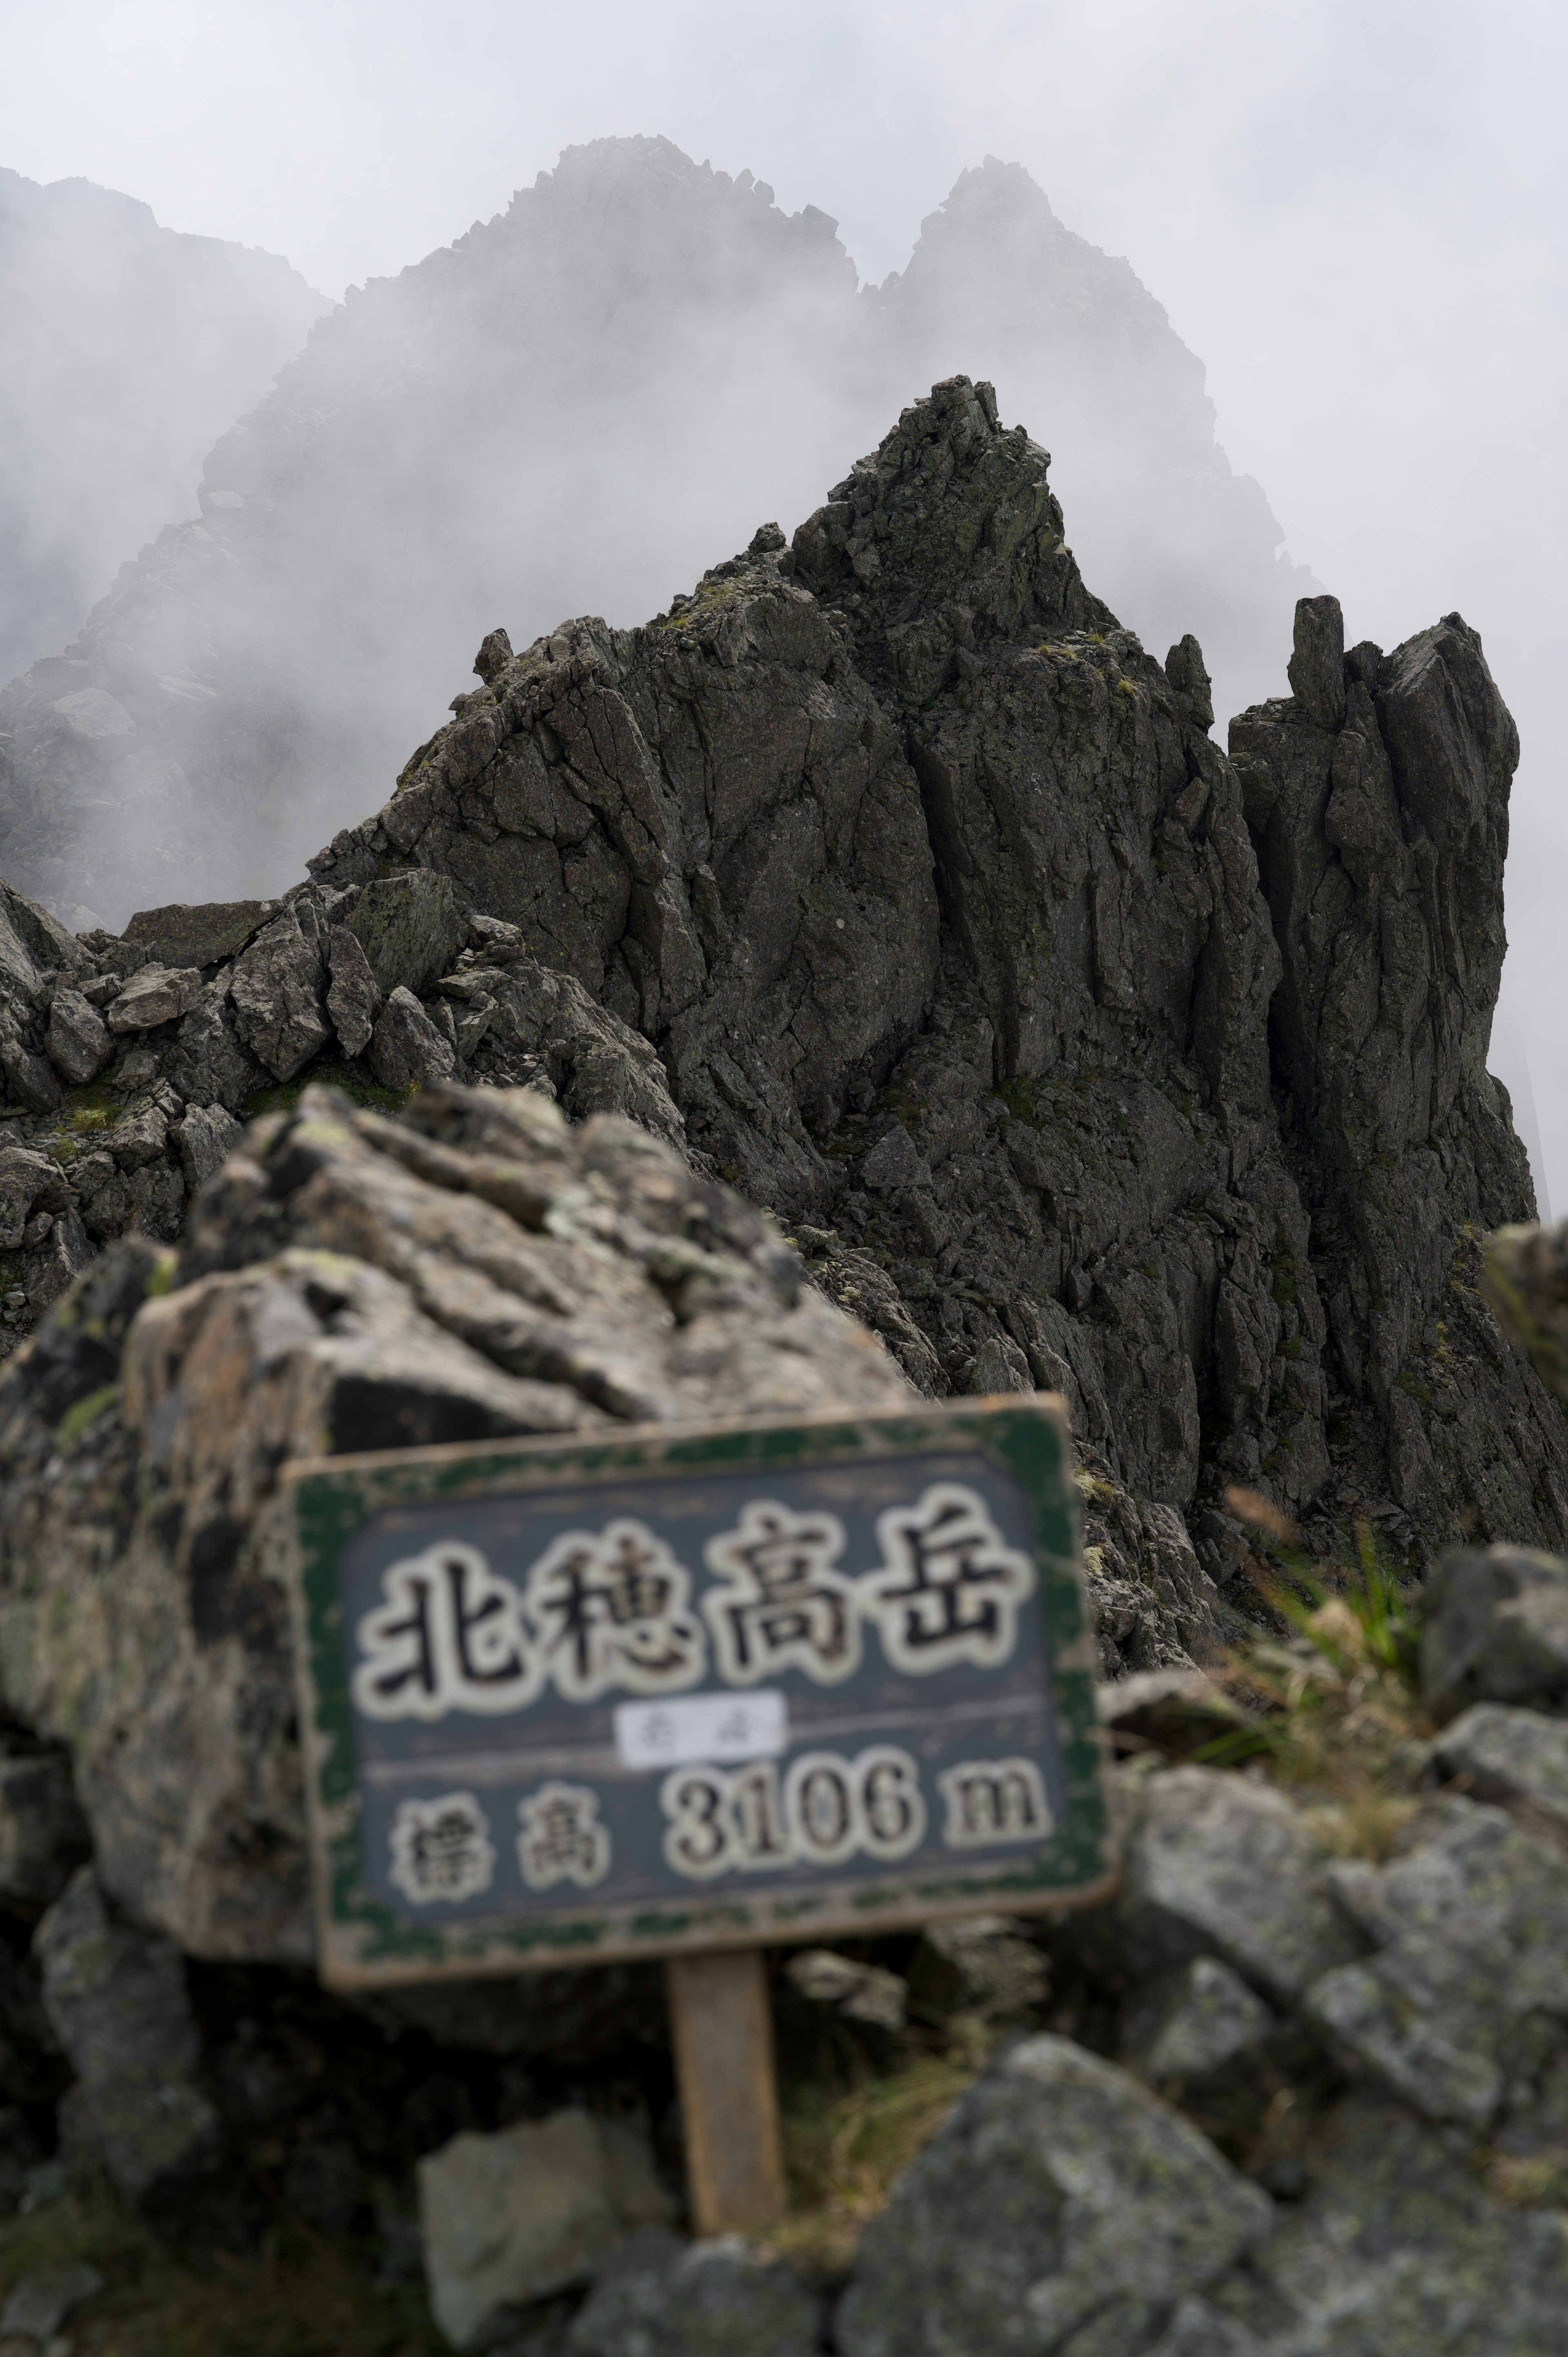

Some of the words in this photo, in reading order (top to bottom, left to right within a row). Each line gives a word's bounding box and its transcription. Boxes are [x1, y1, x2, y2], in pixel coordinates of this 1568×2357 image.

[358, 1489, 1027, 1715] 北穂高岳
[666, 1749, 921, 1876] 3106
[942, 1761, 1051, 1845] m
